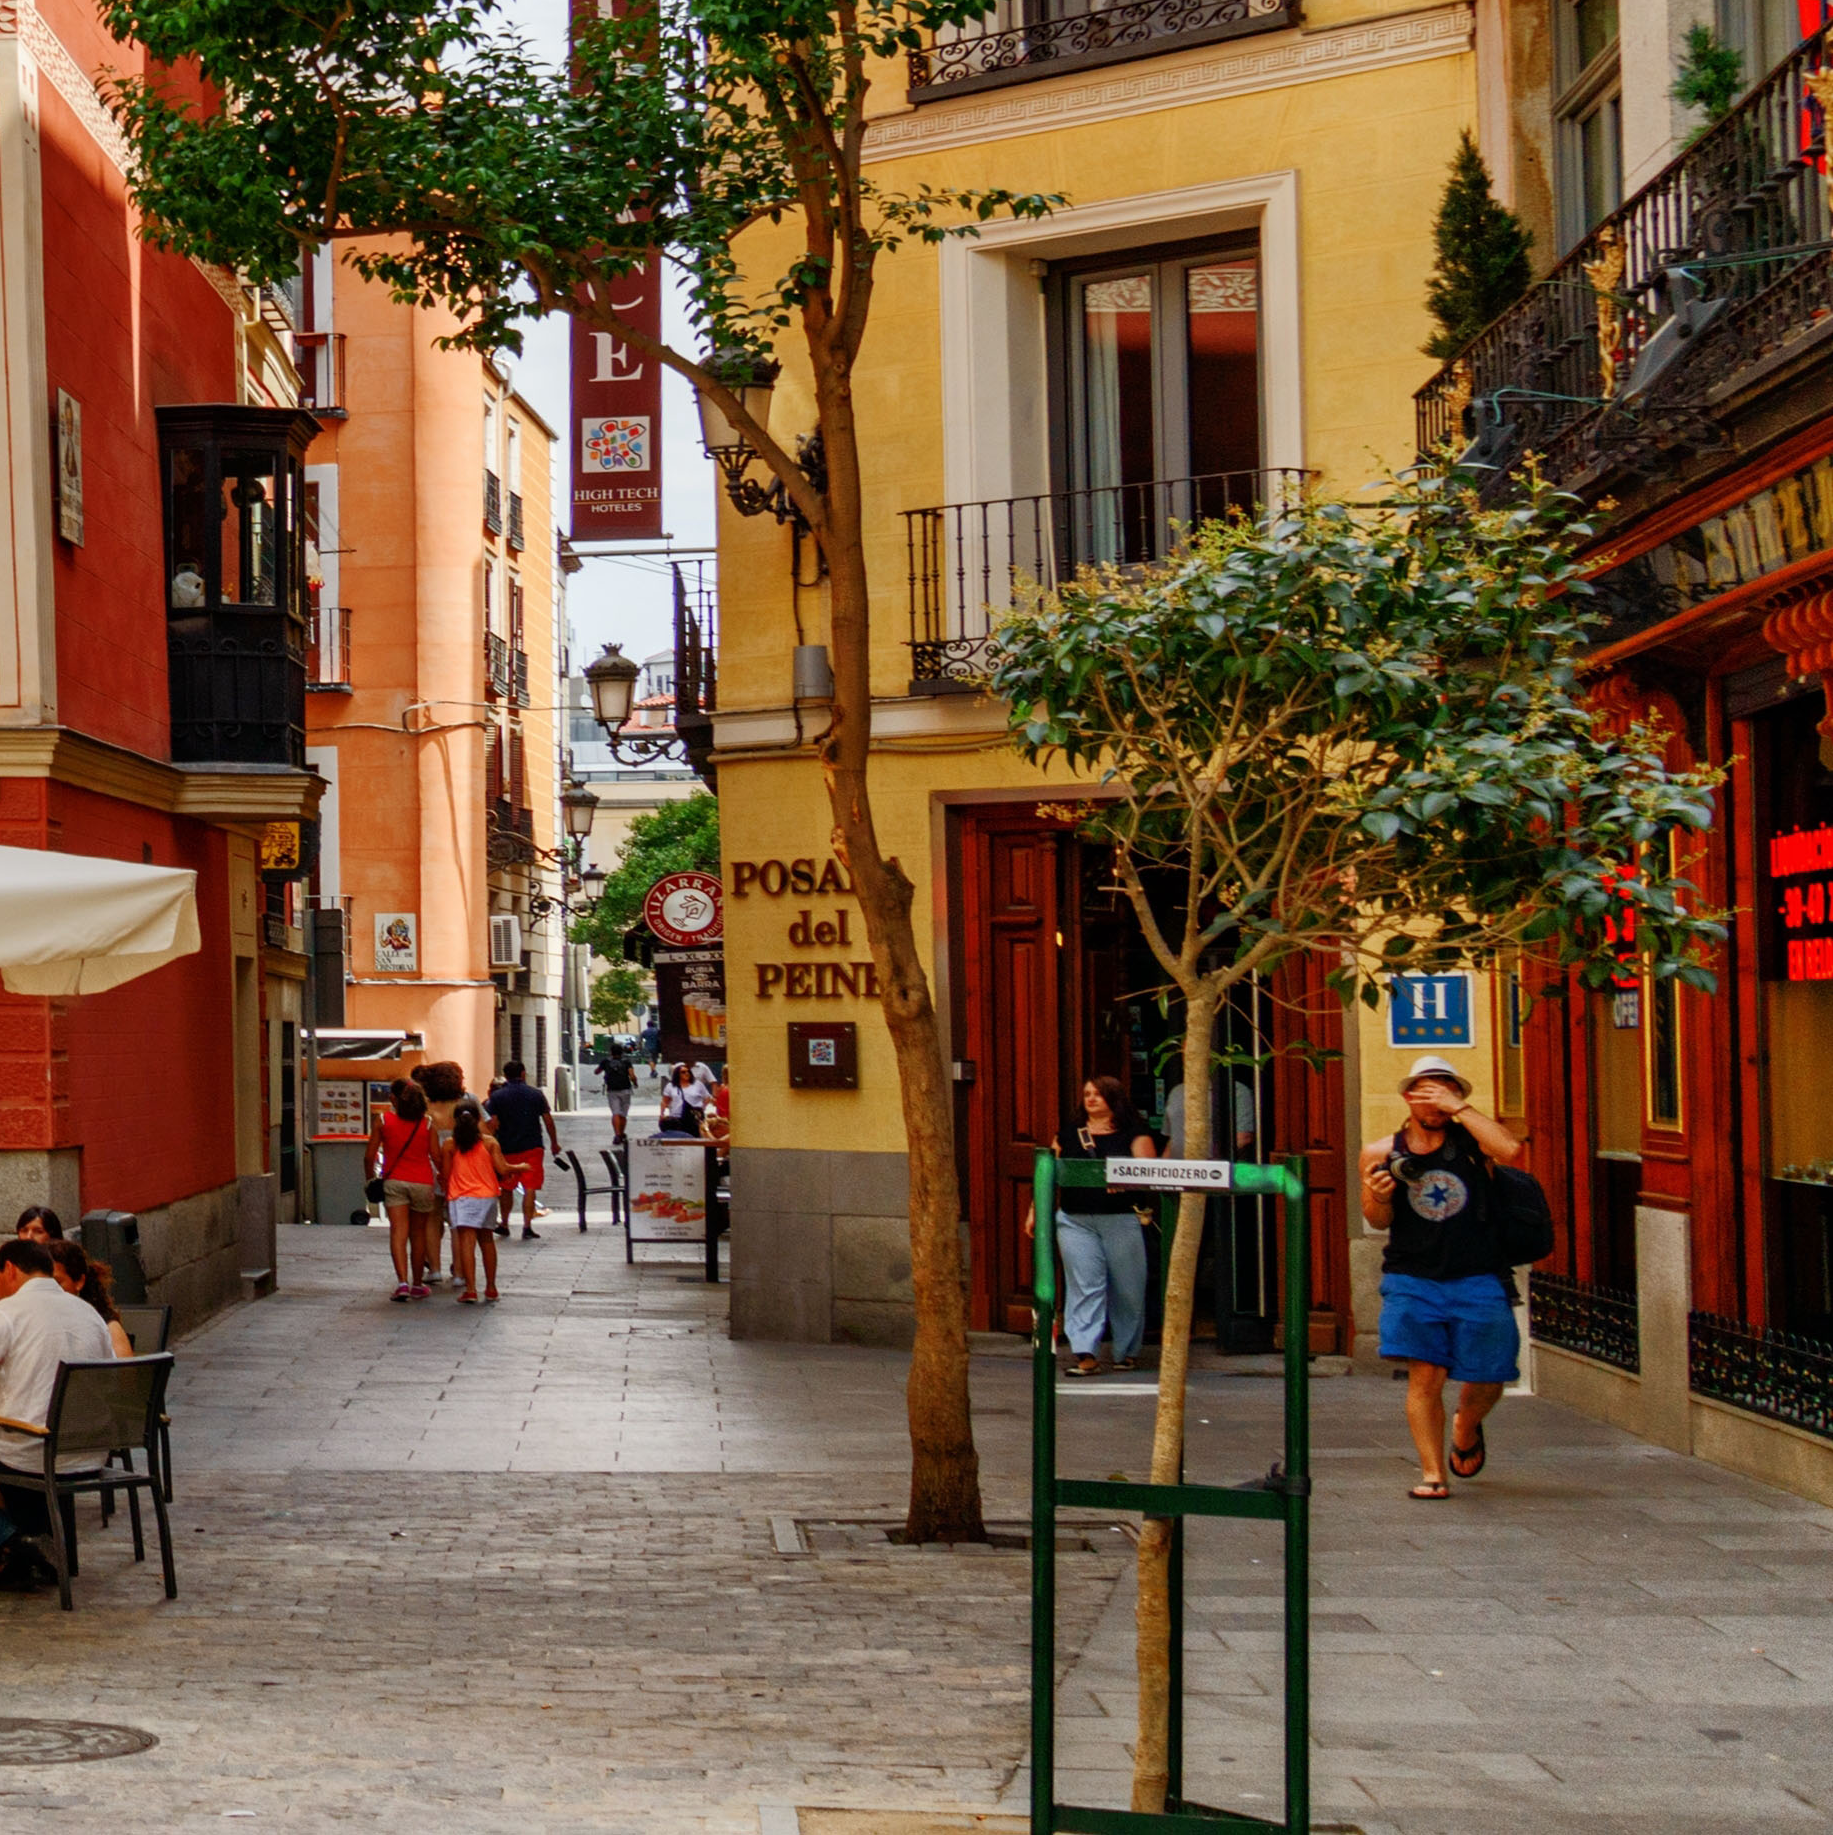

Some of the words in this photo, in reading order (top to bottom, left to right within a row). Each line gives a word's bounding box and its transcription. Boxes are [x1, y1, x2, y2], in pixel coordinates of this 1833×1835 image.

[574, 487, 613, 502] HIGH
[616, 486, 658, 500] TECH
[591, 502, 643, 514] HOTELES
[731, 858, 855, 898] POSA
[789, 909, 852, 946] del
[709, 952, 724, 961] XX
[681, 980, 720, 990] BARRA
